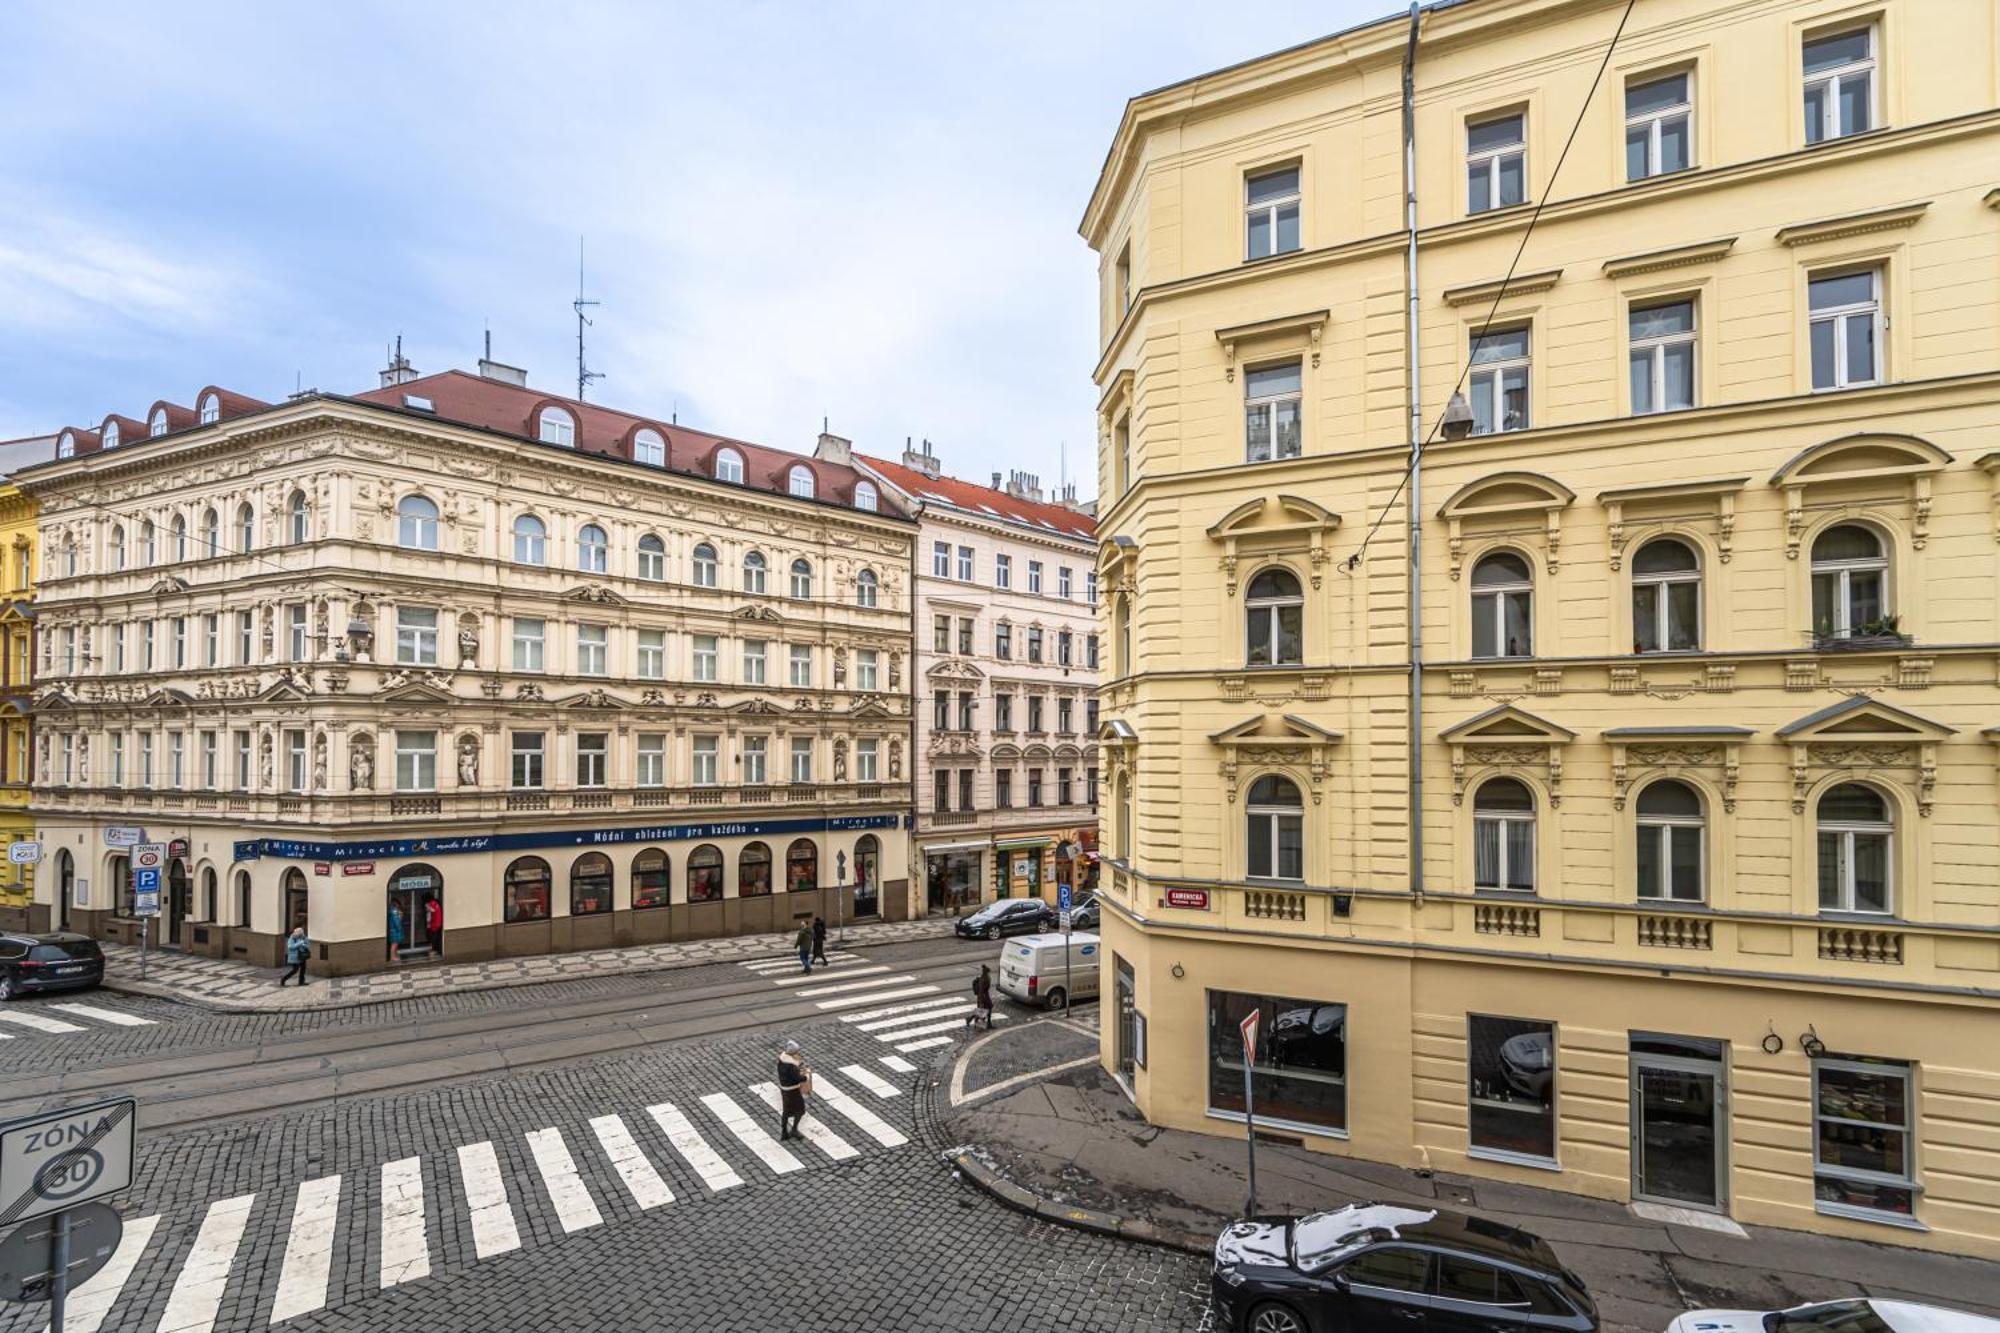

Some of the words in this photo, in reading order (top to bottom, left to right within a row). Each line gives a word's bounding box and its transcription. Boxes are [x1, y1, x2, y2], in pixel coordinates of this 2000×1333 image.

[594, 831, 624, 843] Módní
[687, 828, 703, 838] pro
[711, 823, 746, 836] každého
[143, 855, 154, 863] 30
[141, 872, 155, 885] P
[23, 1115, 112, 1154] ZÓNA
